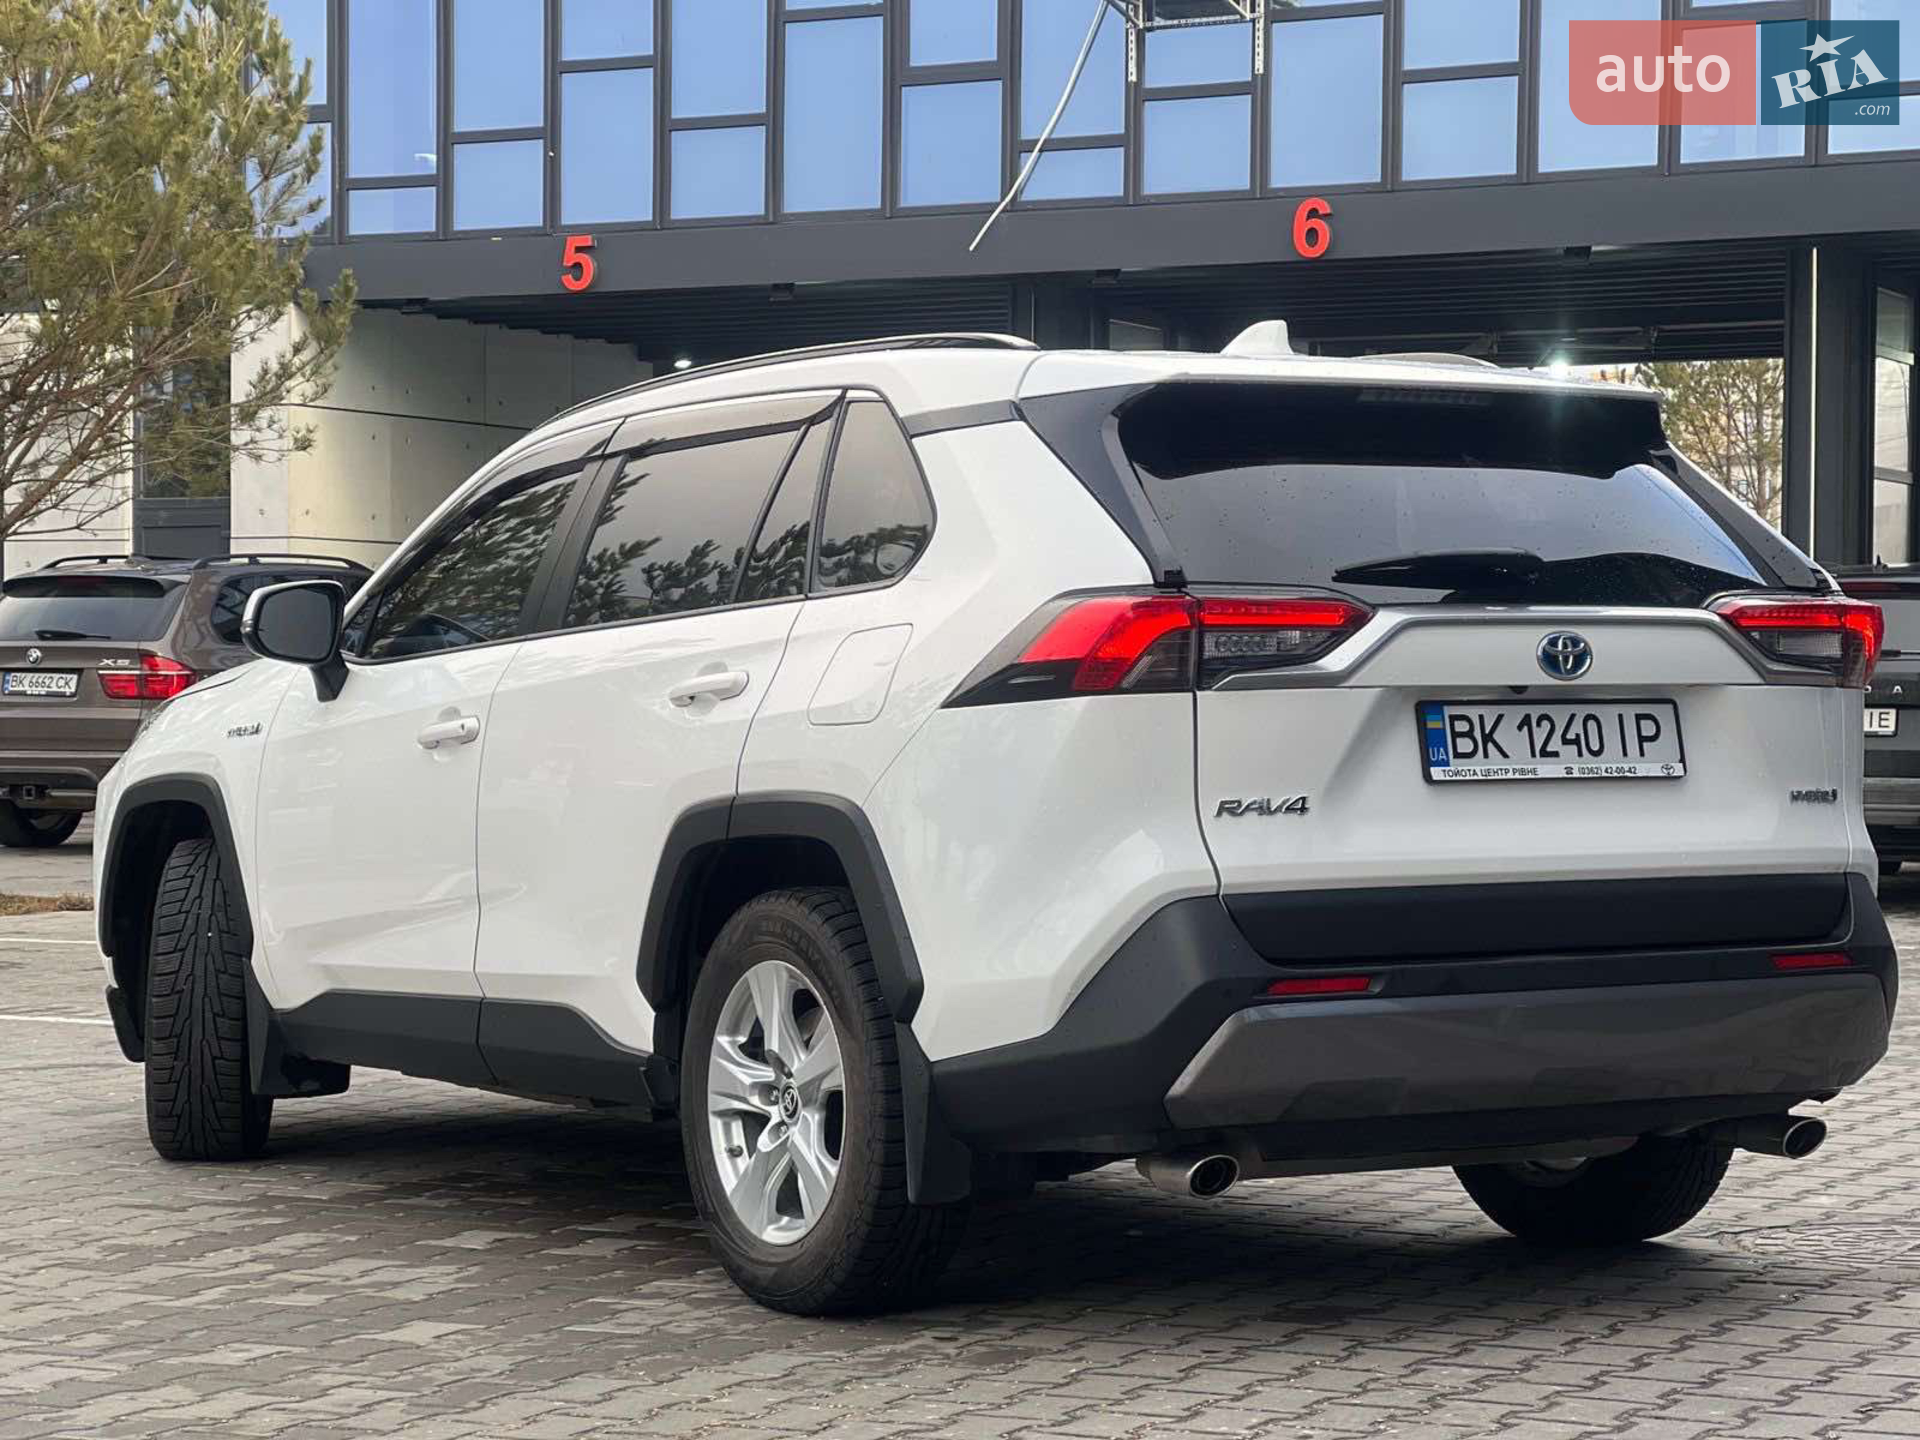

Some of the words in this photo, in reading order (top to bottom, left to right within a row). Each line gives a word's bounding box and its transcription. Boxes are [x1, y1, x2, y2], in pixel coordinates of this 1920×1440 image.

[1293, 197, 1333, 259] 6
[560, 234, 597, 293] 5
[11, 674, 26, 689] BK
[28, 674, 53, 688] 6662
[55, 675, 74, 691] CK
[1448, 713, 1510, 759] BK
[1516, 712, 1605, 758] 1240
[1617, 712, 1662, 758] IP
[1429, 746, 1448, 762] UA
[1480, 767, 1511, 779] ЦЕНТР
[1577, 766, 1603, 777] (0362)
[1604, 765, 1638, 776] 42-00-42
[1213, 795, 1309, 818] RAV4
